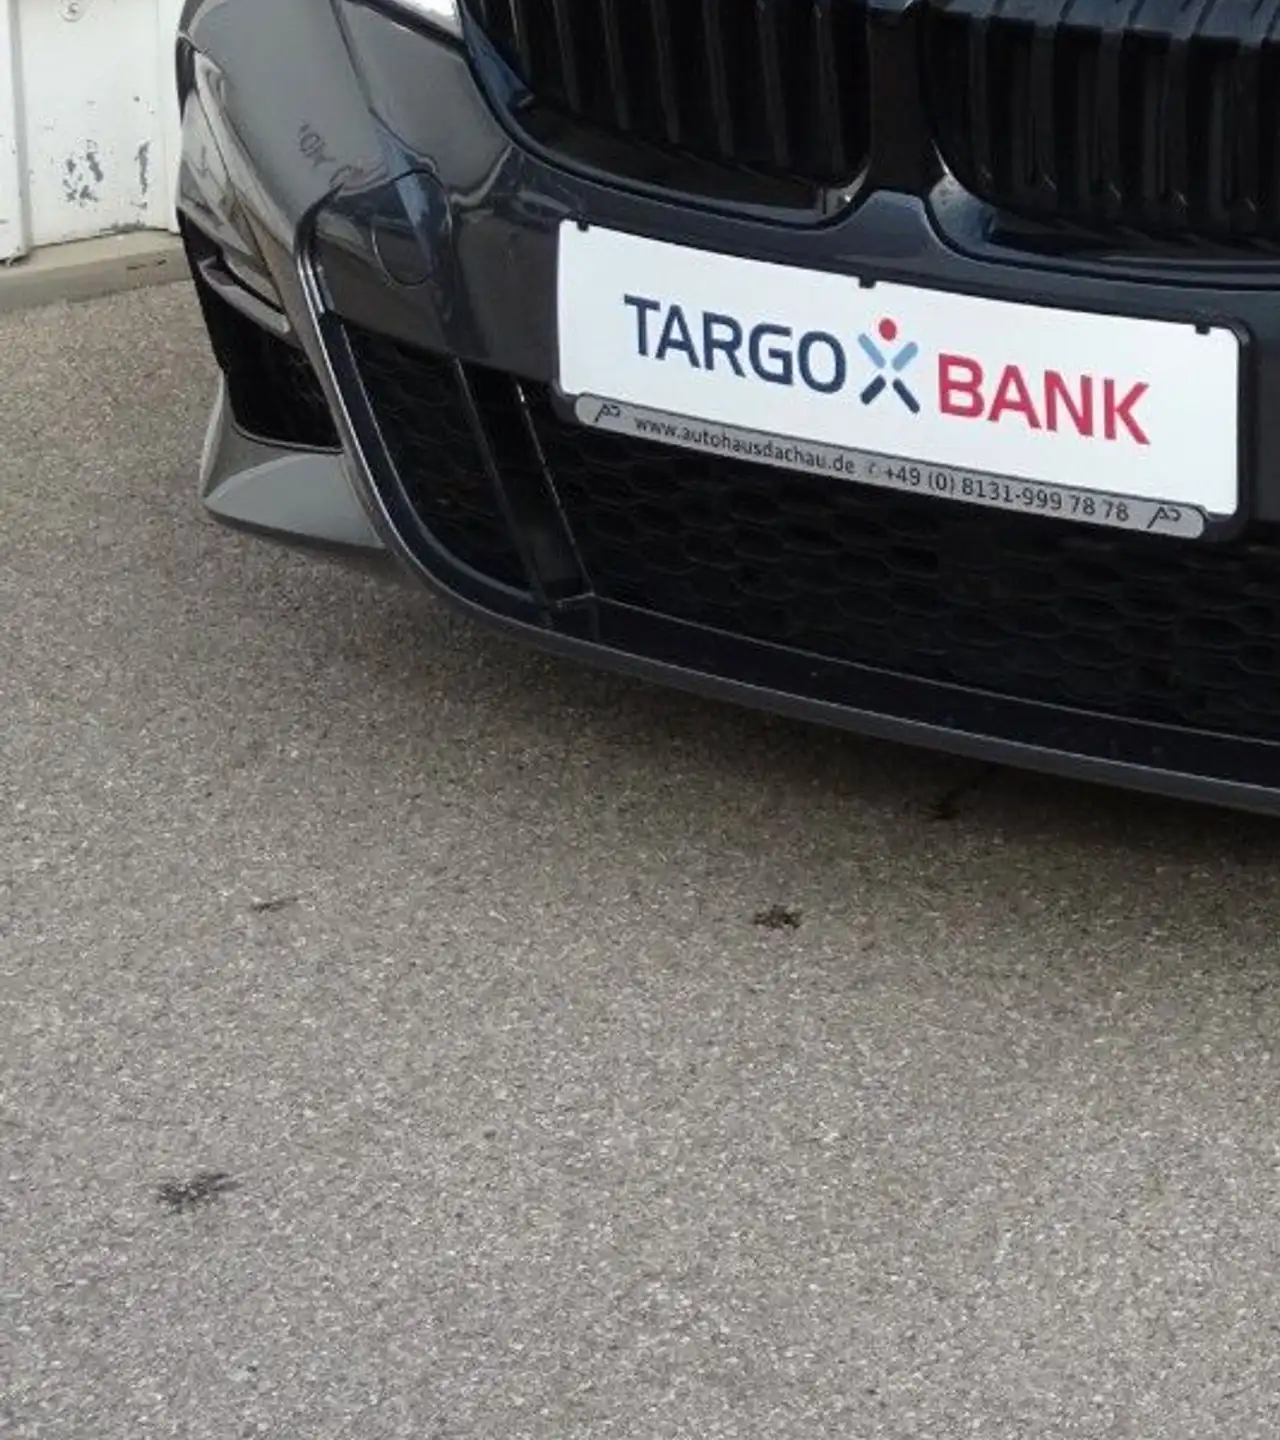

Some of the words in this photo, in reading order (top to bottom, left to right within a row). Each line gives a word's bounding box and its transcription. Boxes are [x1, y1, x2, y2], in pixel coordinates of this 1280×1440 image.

[623, 293, 848, 394] TARGO
[937, 353, 1151, 446] BANK
[634, 416, 857, 475] www.autohausdachau.de
[885, 464, 922, 487] +49
[928, 471, 956, 495] (0)
[961, 478, 1063, 512] 8131-999
[1070, 494, 1097, 517] 78
[1102, 499, 1131, 523] 78
